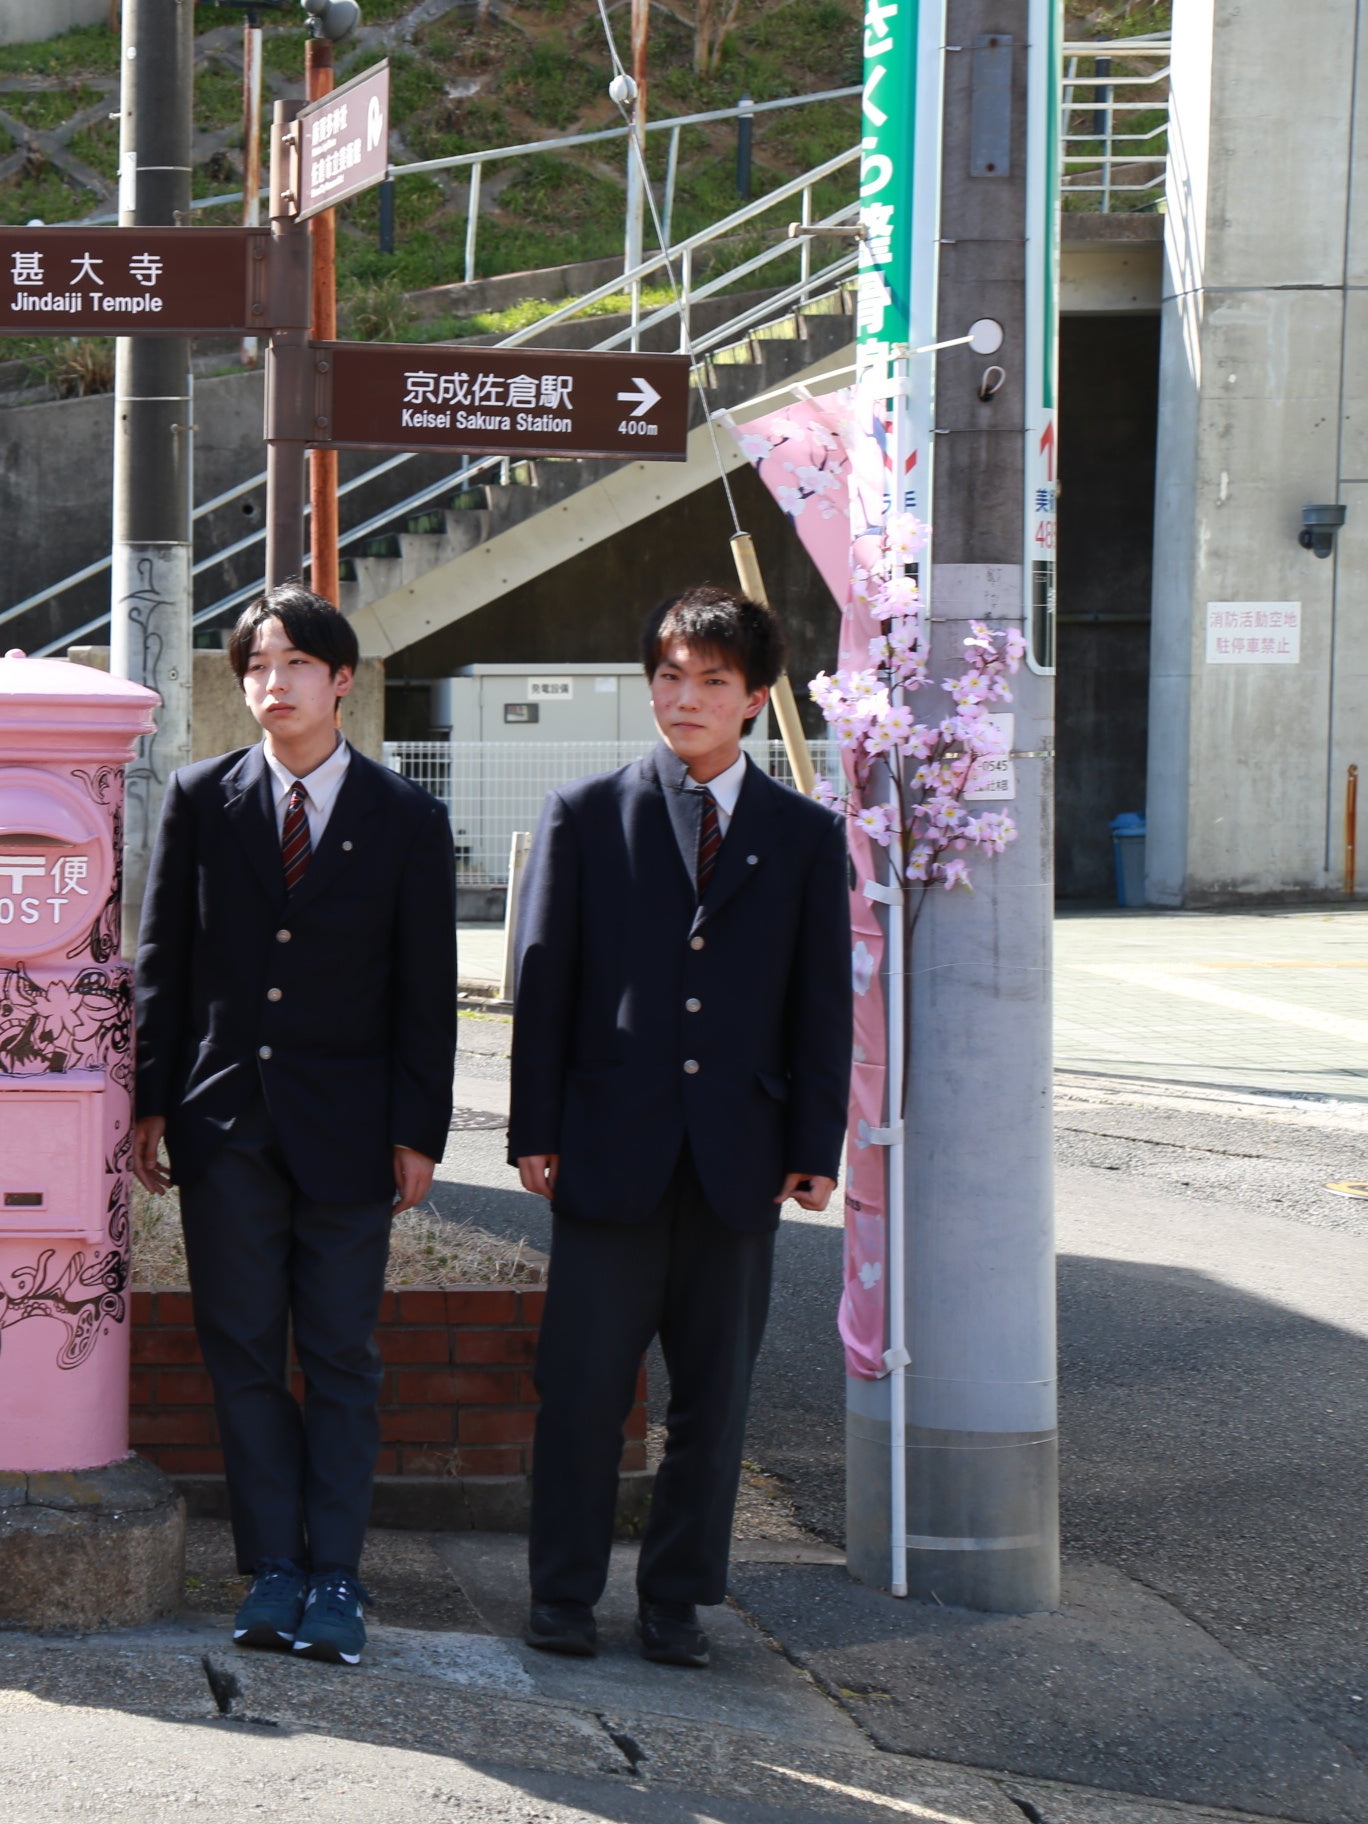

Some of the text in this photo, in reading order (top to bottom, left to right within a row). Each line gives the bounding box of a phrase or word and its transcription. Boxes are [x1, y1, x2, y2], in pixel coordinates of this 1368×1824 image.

[10, 251, 163, 287] 甚大寺
[11, 292, 163, 314] Jindaiji Temple
[403, 370, 573, 410] 京成佐倉駅
[401, 408, 572, 433] Keisei Sakura Station
[617, 421, 658, 436] 400m
[1035, 520, 1056, 549] 48
[1210, 611, 1297, 628] 消防活動空地
[1216, 637, 1291, 654] 駐停車禁止
